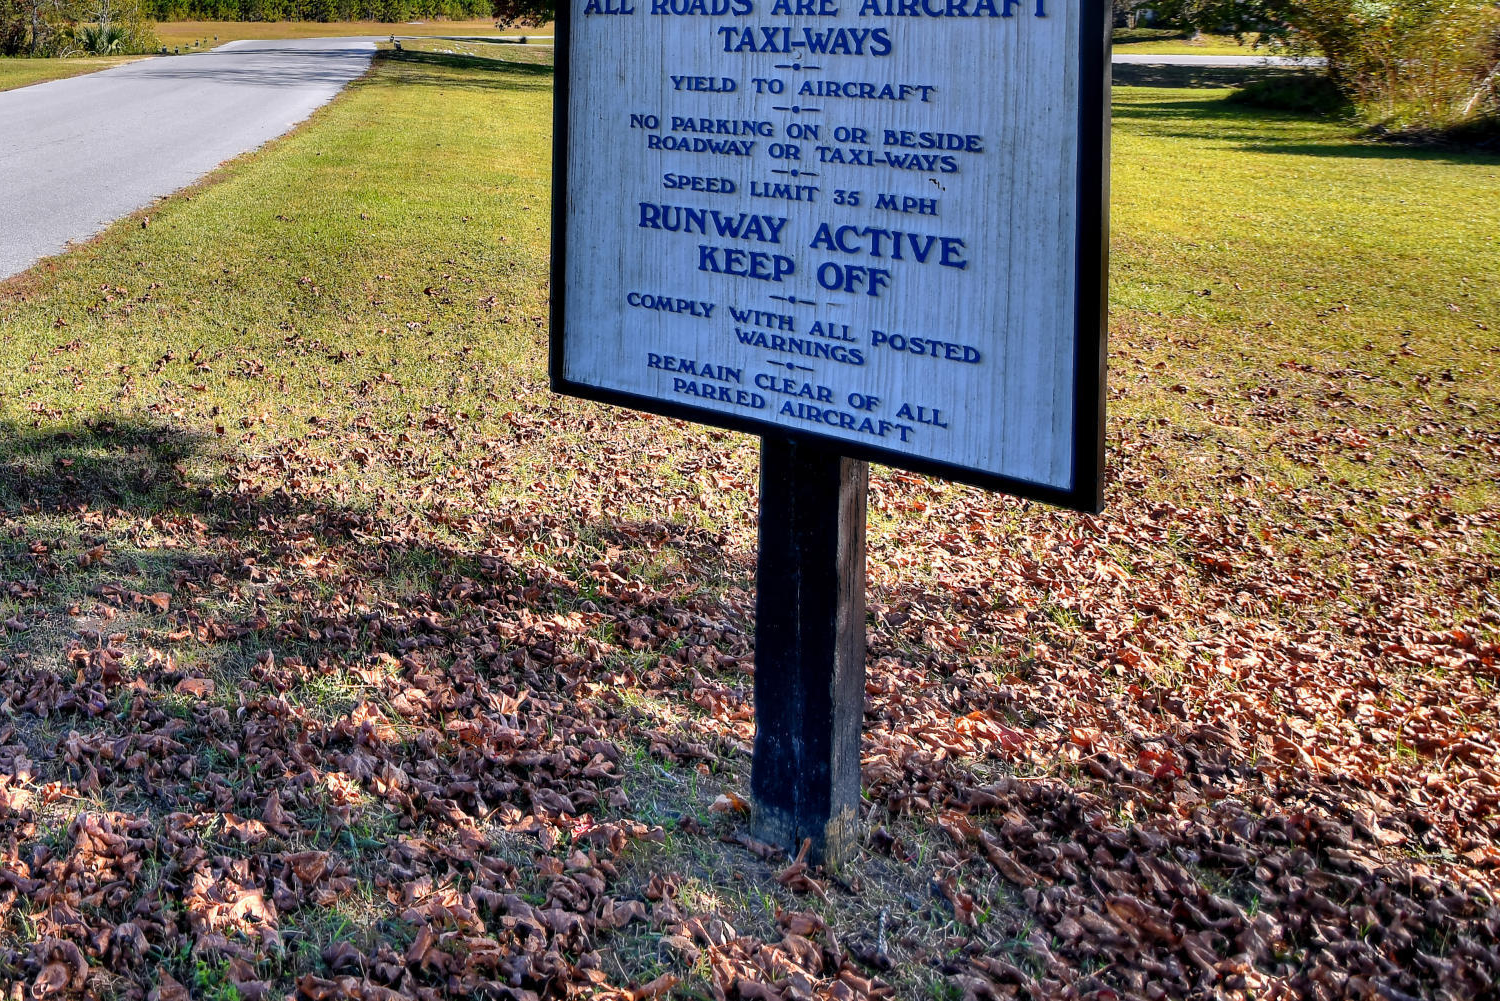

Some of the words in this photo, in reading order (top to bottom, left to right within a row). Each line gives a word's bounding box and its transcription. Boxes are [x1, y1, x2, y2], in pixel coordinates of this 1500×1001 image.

[718, 26, 893, 56] TAXI-WAYS
[670, 76, 738, 93] YIELD
[752, 78, 784, 94] TO
[798, 81, 936, 102] AIRCRAFT
[631, 114, 660, 129] NO
[672, 117, 774, 137] PARKING
[786, 123, 820, 140] ON
[834, 127, 869, 144] OR
[883, 130, 982, 153] BESIDE
[648, 135, 757, 156] ROADWAY
[768, 143, 801, 160] OR
[816, 146, 957, 173] TAXI-WAYS
[663, 173, 737, 194] SPEED
[750, 181, 820, 202] LIMIT
[834, 190, 860, 206] 35
[875, 194, 938, 216] MPH
[639, 202, 788, 243] RUNWAY
[809, 223, 968, 270] ACTIVE
[698, 245, 796, 282] KEEP
[817, 262, 892, 297] OFF
[627, 293, 716, 318] COMPLY
[729, 306, 794, 332] WITH
[809, 321, 856, 342] ALL
[872, 330, 982, 364] POSTED
[736, 328, 864, 366] WARNINGS
[647, 353, 742, 384] REMAIN
[754, 374, 833, 403] CLEAR
[848, 393, 881, 411] OF
[896, 403, 948, 429] ALL
[674, 378, 765, 409] PARKED
[780, 402, 915, 442] AIRCRAFT
